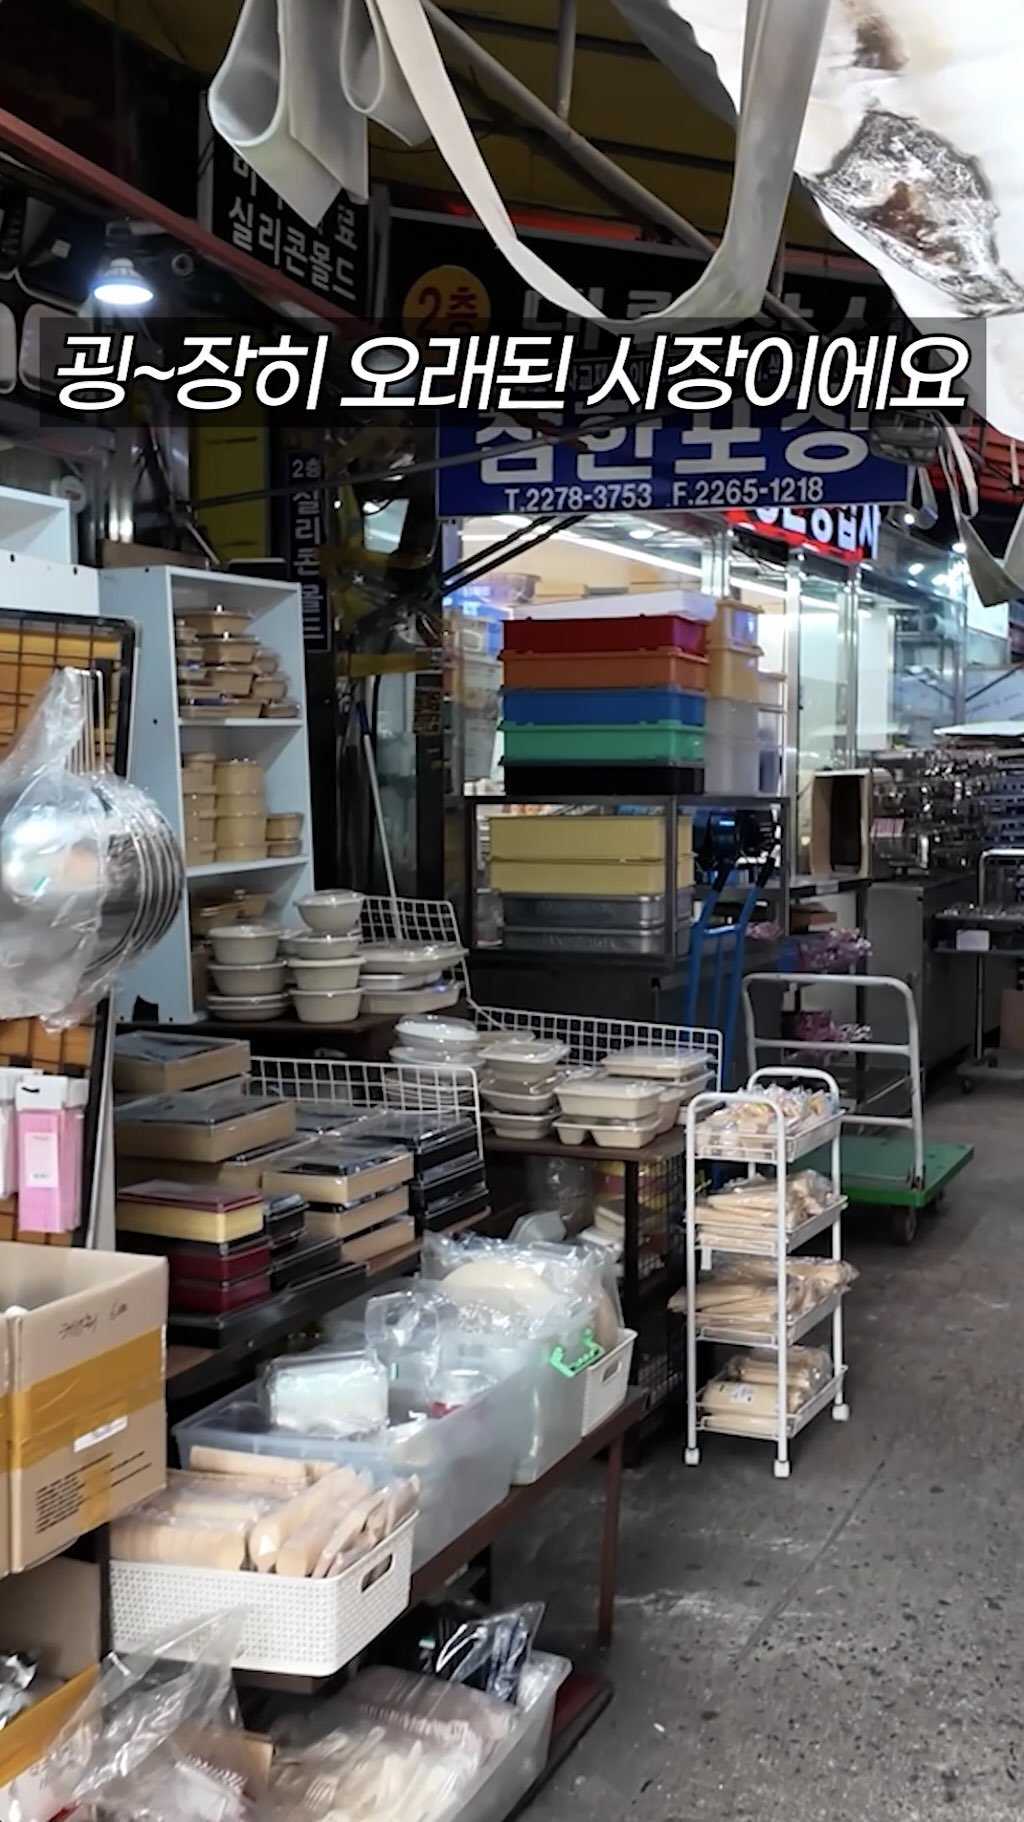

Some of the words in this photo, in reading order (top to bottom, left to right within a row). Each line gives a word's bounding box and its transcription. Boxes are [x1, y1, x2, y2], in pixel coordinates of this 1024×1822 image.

[228, 196, 357, 301] 실리콘몰드
[291, 458, 321, 479] 2층
[504, 484, 653, 513] T.2278-3753
[672, 476, 824, 506] F.2265-1218
